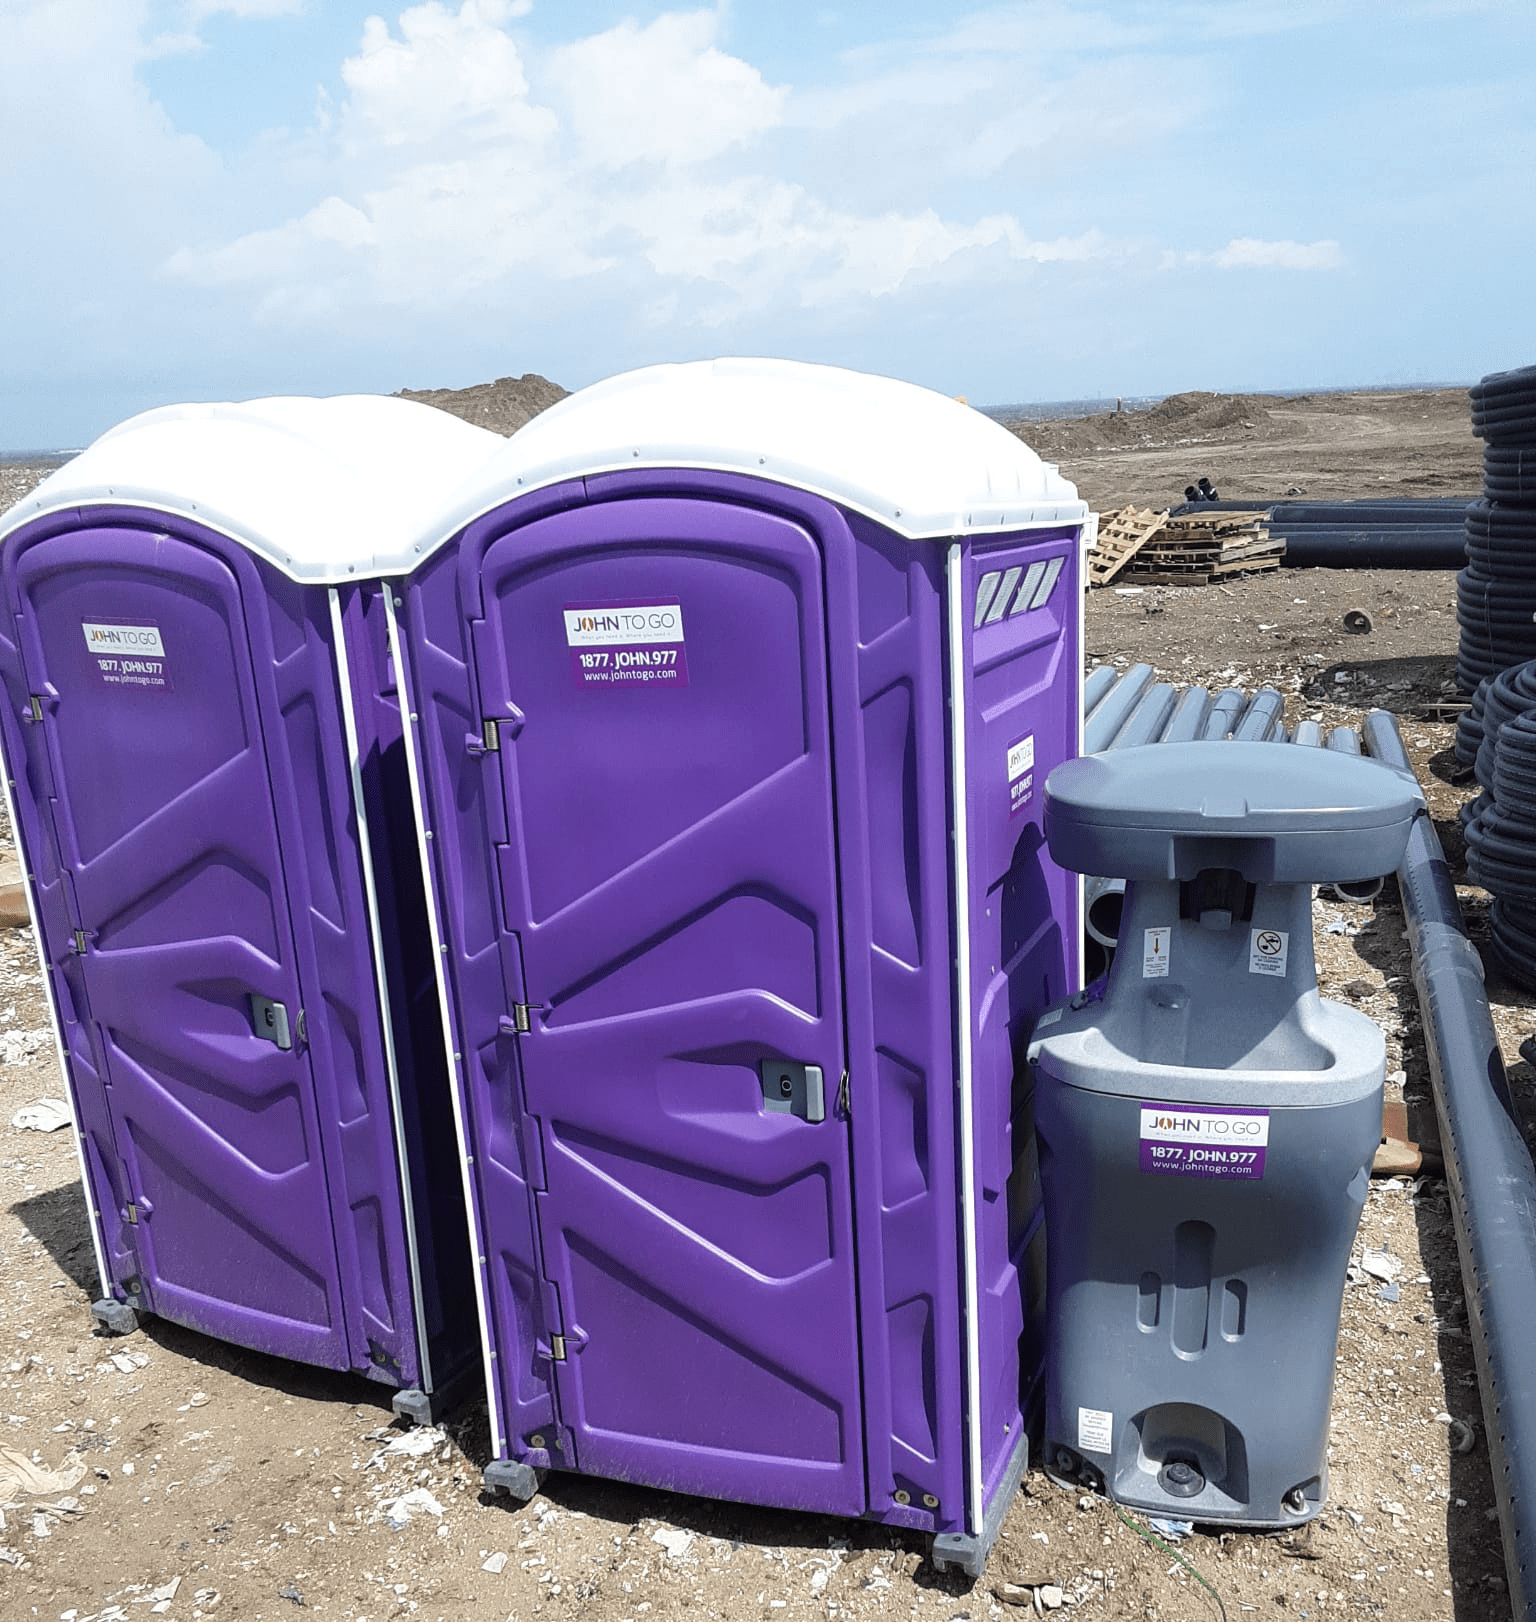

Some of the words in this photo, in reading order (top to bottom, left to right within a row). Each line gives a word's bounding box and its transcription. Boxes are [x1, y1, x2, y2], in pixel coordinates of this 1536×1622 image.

[574, 615, 619, 632] JOHN
[621, 614, 645, 630] TO
[648, 613, 675, 629] GO
[91, 629, 121, 643] JOHN
[120, 631, 138, 645] TO
[138, 632, 158, 646] GO
[584, 669, 677, 682] www.johntogo.com
[1149, 1116, 1200, 1132] JOHN
[1203, 1119, 1229, 1133] TO
[1232, 1121, 1261, 1135] GO
[1152, 1160, 1252, 1174] www.johntogo.com
